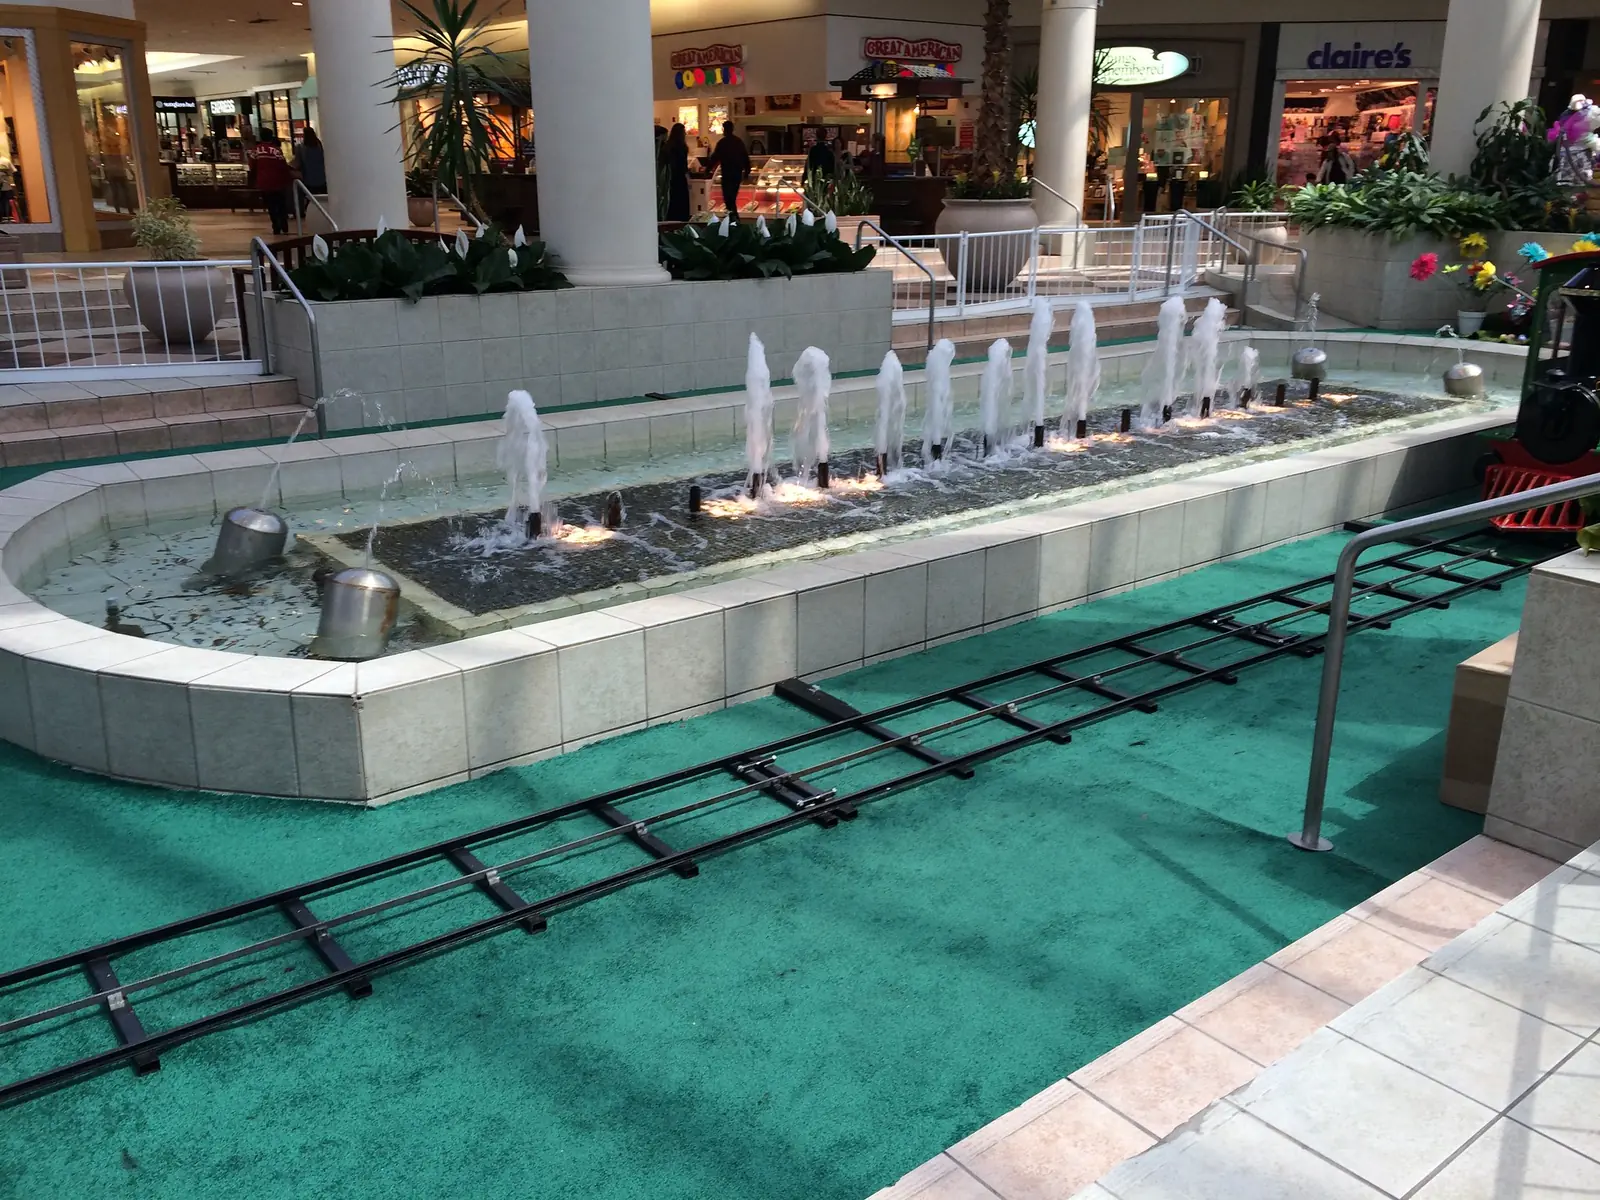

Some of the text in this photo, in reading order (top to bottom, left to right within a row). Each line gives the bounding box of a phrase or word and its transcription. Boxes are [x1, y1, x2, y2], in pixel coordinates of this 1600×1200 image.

[867, 40, 961, 61] GREAT AMERICAN
[1307, 42, 1412, 69] claire's
